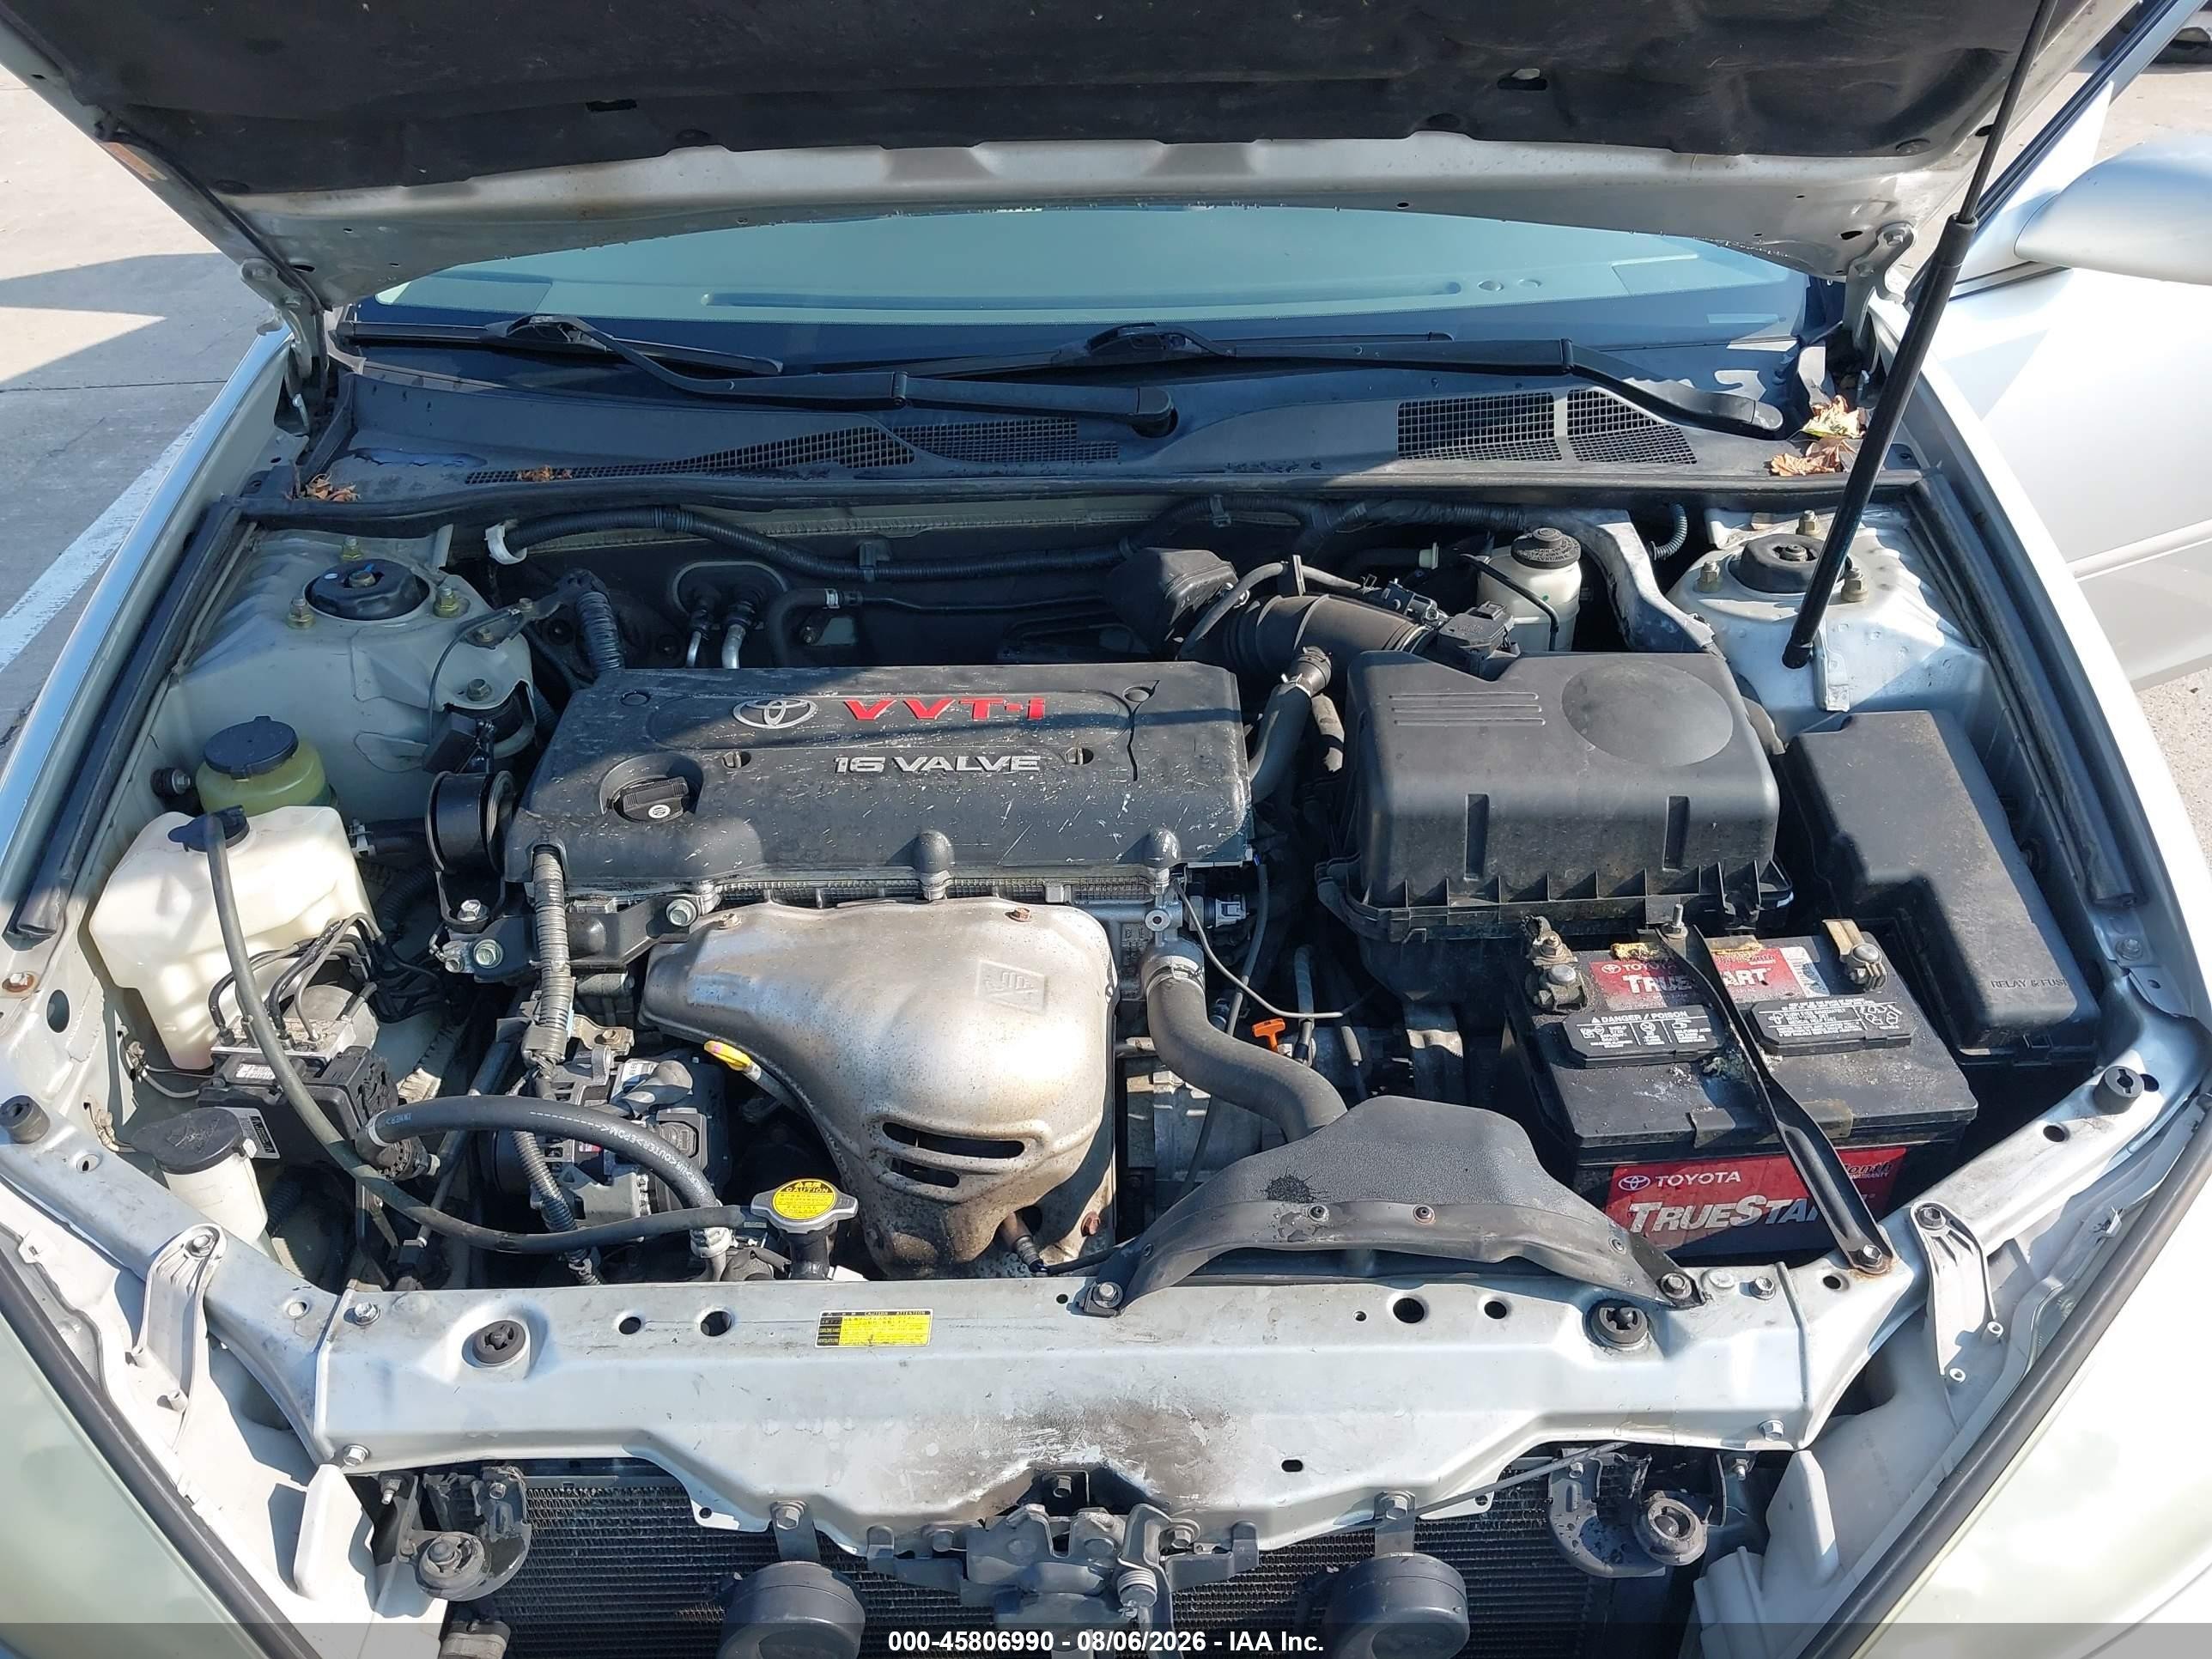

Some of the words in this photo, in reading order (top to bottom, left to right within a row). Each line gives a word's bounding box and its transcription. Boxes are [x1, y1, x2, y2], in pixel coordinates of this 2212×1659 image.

[833, 756, 886, 774] 16
[892, 756, 1041, 774] VALVE
[1990, 979, 2026, 988] RELAY
[2031, 979, 2039, 988] &
[1601, 1013, 1642, 1024] DANGER
[1650, 1011, 1688, 1020] POISON
[1655, 1170, 1742, 1188] TOYOTA
